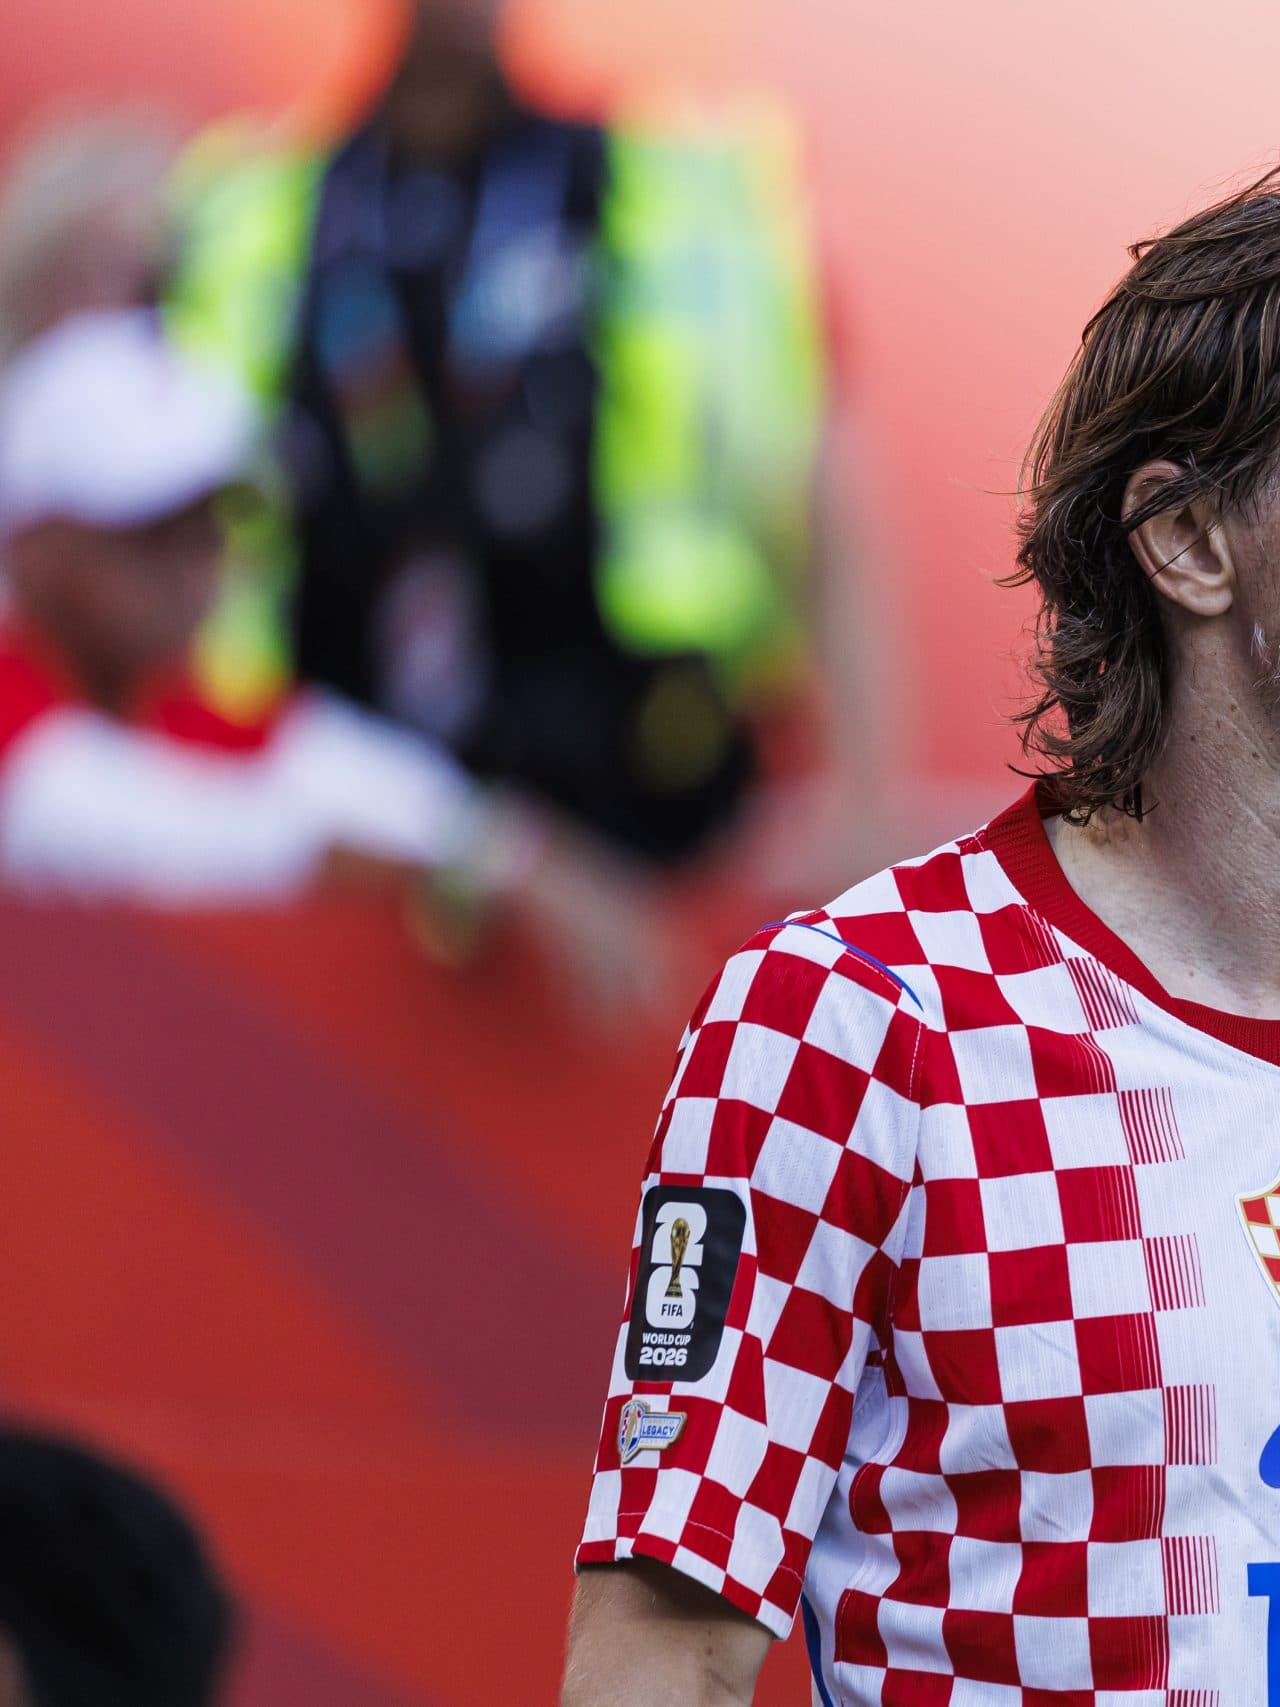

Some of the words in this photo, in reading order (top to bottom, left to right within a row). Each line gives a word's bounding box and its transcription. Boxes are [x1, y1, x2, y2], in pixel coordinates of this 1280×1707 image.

[661, 1303, 684, 1317] FIFA
[642, 1332, 675, 1346] WORLD
[674, 1334, 692, 1346] CUP
[639, 1346, 688, 1367] 2026
[642, 1425, 675, 1436] LEGACY
